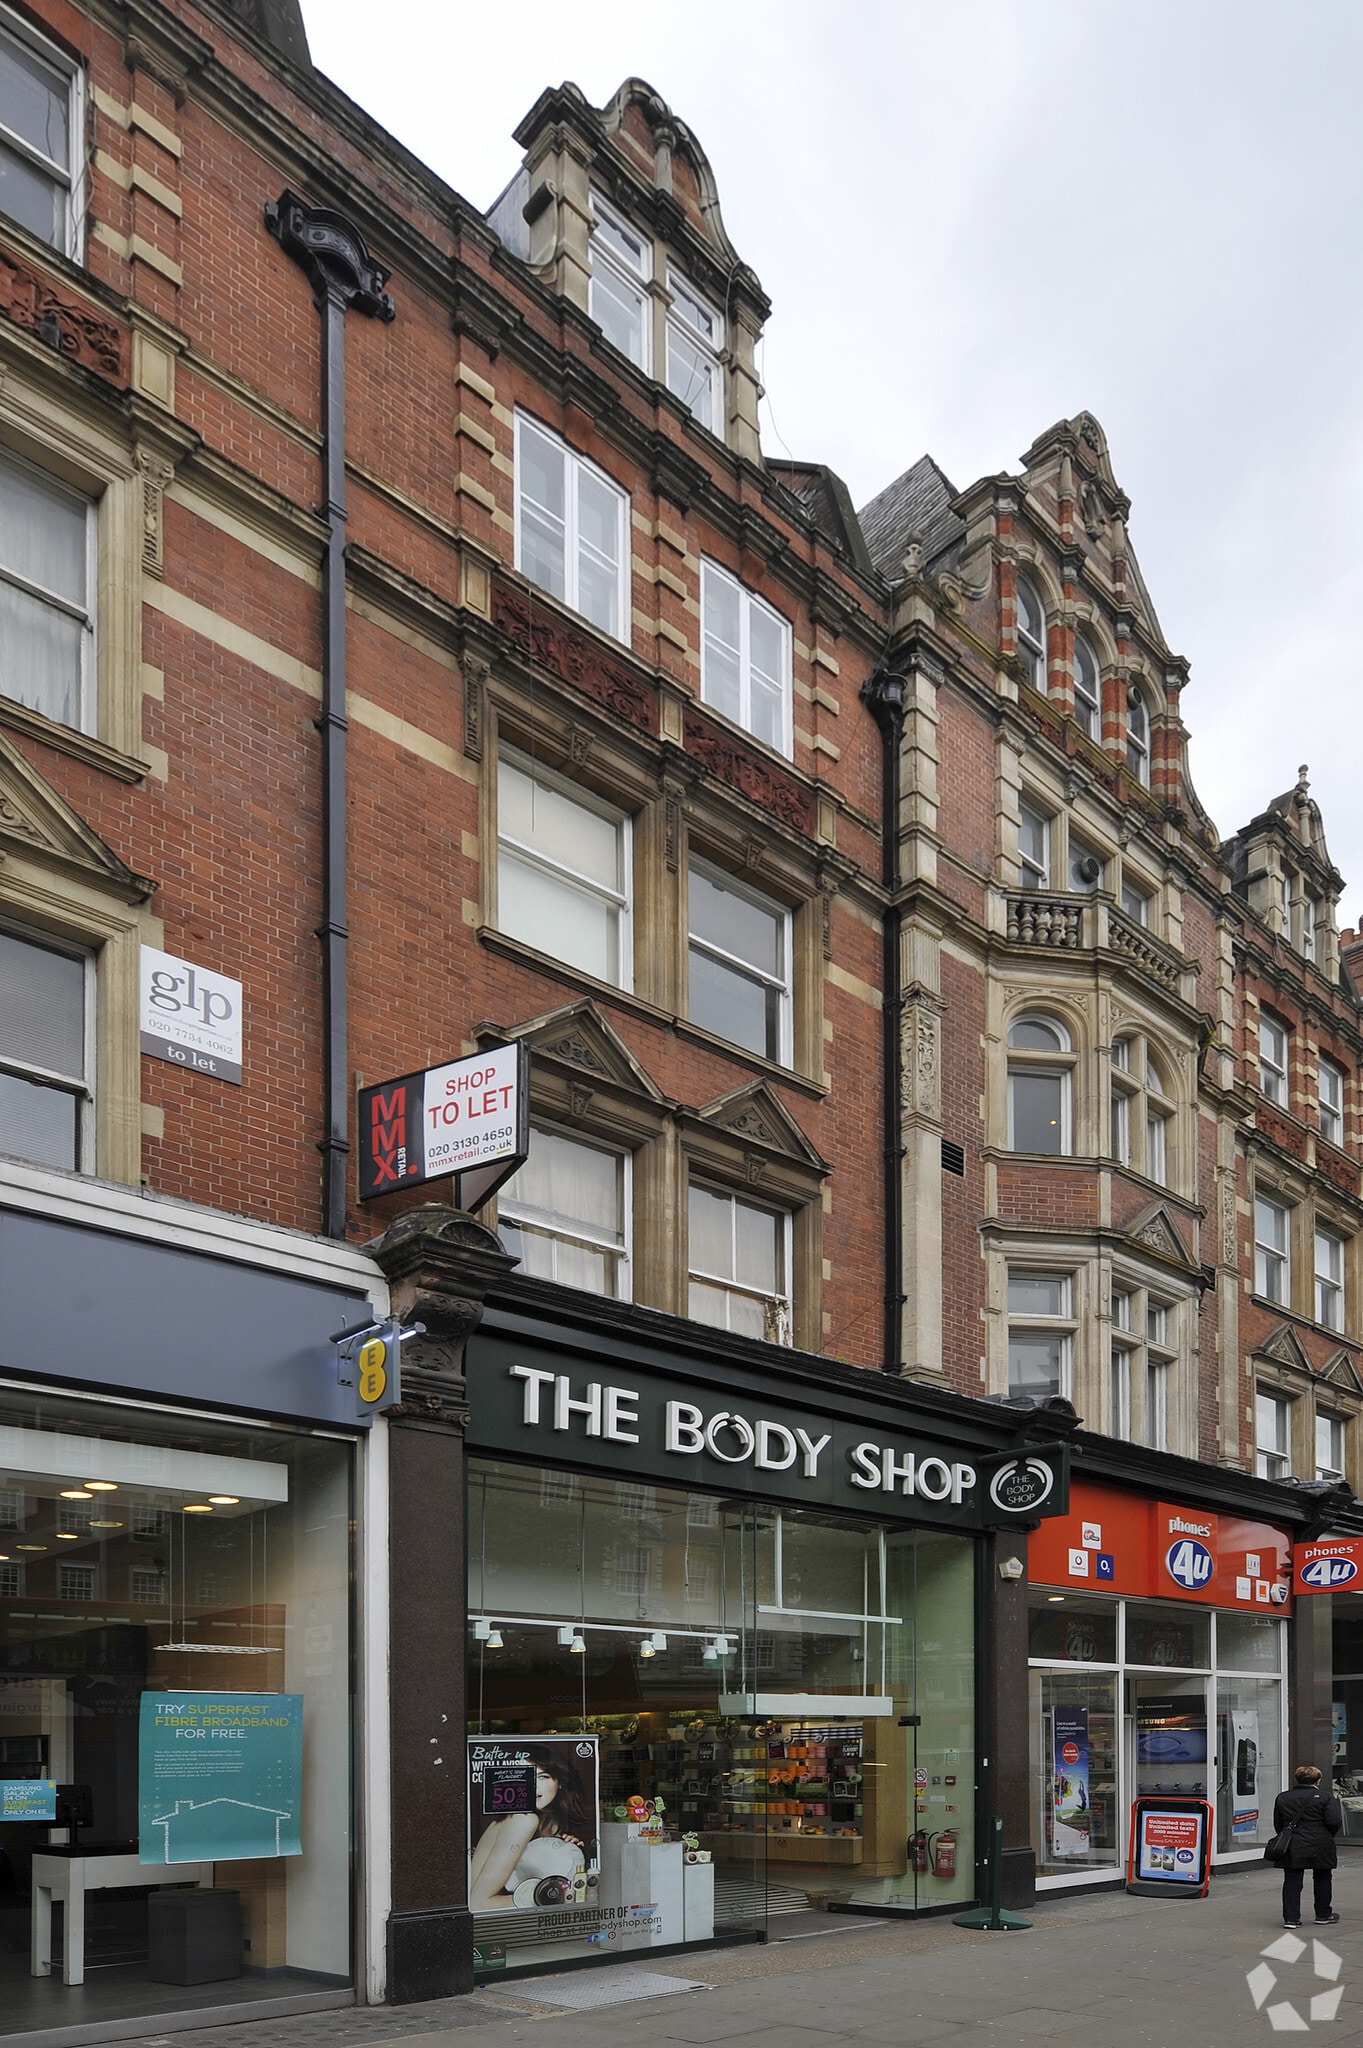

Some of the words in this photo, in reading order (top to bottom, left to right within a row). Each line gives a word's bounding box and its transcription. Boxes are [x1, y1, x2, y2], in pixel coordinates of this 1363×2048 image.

[149, 966, 232, 1028] glp
[148, 1018, 170, 1033] 020
[174, 1027, 202, 1044] 7734
[206, 1039, 233, 1055] 4062
[166, 1045, 186, 1061] to
[192, 1052, 217, 1072] let
[445, 1067, 496, 1096] SHOP
[428, 1101, 460, 1129] TO
[468, 1085, 514, 1118] LET
[428, 1144, 450, 1158] 020
[452, 1136, 480, 1152] 3130
[483, 1126, 513, 1143] 4650
[428, 1139, 513, 1169] mmxretail.co.uk
[398, 1146, 407, 1178] RETAIL
[509, 1364, 640, 1444] THE
[665, 1400, 832, 1478] BODY
[850, 1442, 976, 1505] SHOP
[1006, 1484, 1035, 1495] BODY
[1012, 1474, 1030, 1484] THE
[1008, 1493, 1036, 1504] SHOP
[1168, 1516, 1211, 1538] phones
[1305, 1544, 1354, 1559] phones
[1173, 1542, 1210, 1586] 4u
[1306, 1560, 1351, 1586] 4u
[155, 1704, 185, 1714] TRY
[188, 1704, 270, 1714] SUPERFAST
[155, 1716, 198, 1726] FIBRE
[202, 1717, 289, 1726] BROADBAND
[176, 1728, 206, 1738] FOR
[212, 1728, 248, 1738] FREE.
[472, 1746, 512, 1760] Butter
[515, 1750, 530, 1760] up
[538, 1912, 573, 1928] PROUD
[574, 1908, 614, 1923] PARTNER
[617, 1906, 628, 1918] OF
[580, 1916, 662, 1932] thebodyshop.com
